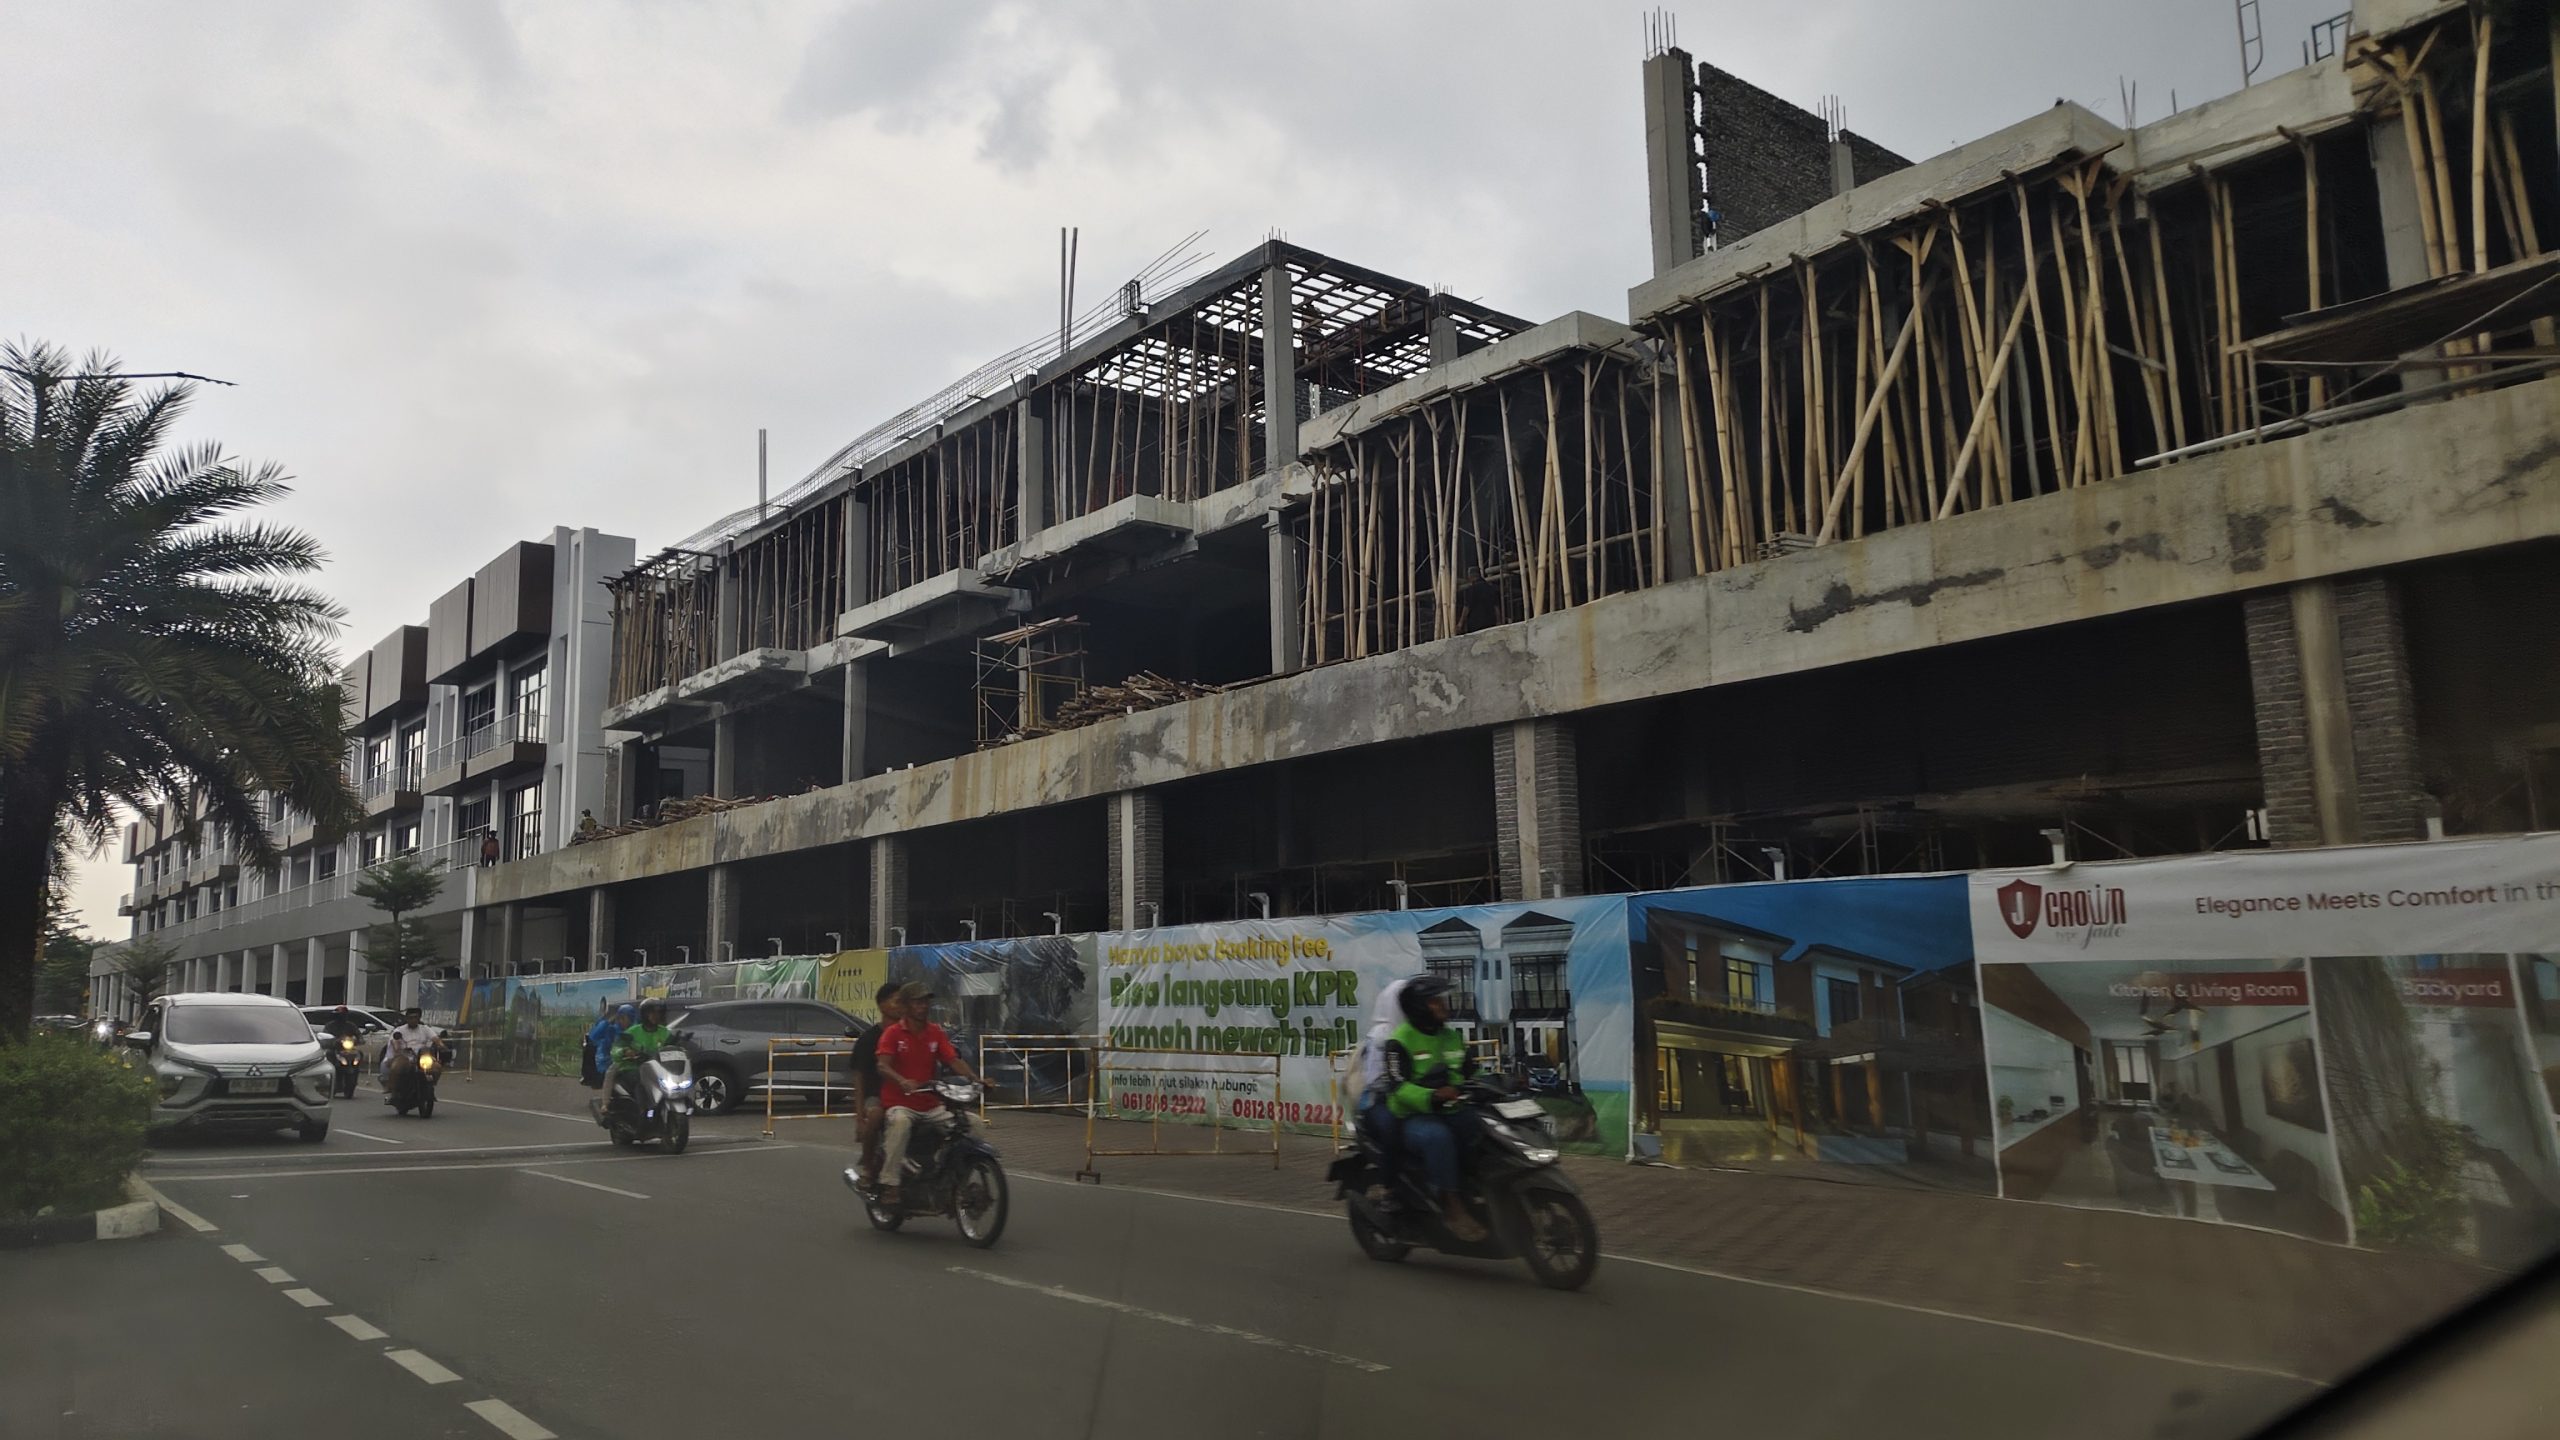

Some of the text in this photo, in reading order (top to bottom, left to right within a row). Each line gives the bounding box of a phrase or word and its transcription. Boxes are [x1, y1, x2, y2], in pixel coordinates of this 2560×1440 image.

[2195, 896, 2301, 919] Elegance
[2306, 891, 2380, 912] Meets
[2388, 884, 2498, 908] Comfort
[2503, 883, 2529, 903] in
[1108, 933, 1333, 969] Hanya bayar Booking Fee,
[1110, 970, 1359, 1018] Bisa langsung KPR
[2109, 980, 2297, 1002] Kitchen & Living Room
[2402, 979, 2502, 1000] Backyard
[1109, 1016, 1358, 1057] rumah mewah ini!
[1112, 1075, 1128, 1086] Info
[1130, 1075, 1151, 1087] lebih
[1153, 1075, 1176, 1091] lnjut
[1122, 1092, 1143, 1110] 061
[1304, 1103, 1345, 1125] 2222
